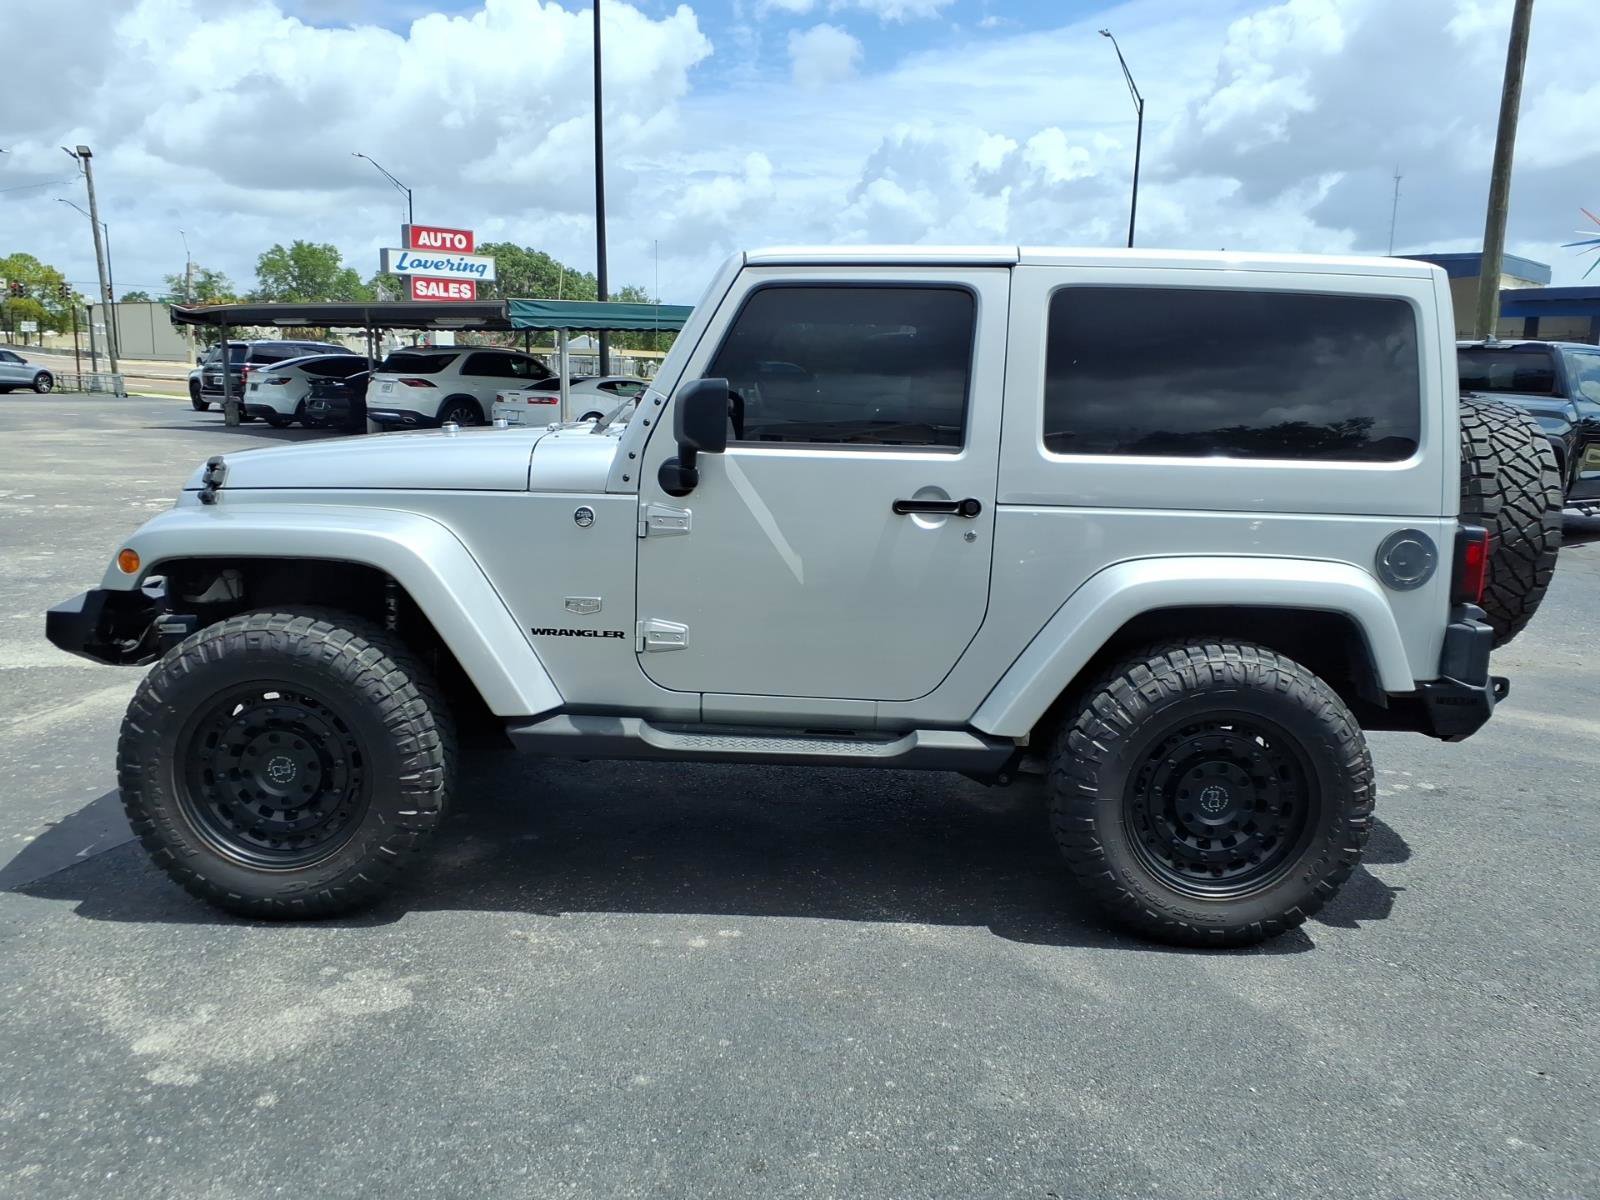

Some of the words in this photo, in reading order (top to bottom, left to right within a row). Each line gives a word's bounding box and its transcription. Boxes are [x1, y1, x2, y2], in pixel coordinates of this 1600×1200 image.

[418, 231, 467, 249] AUTO
[396, 252, 488, 277] Lovering
[415, 280, 471, 299] SALES
[531, 628, 625, 639] WRANGLER
